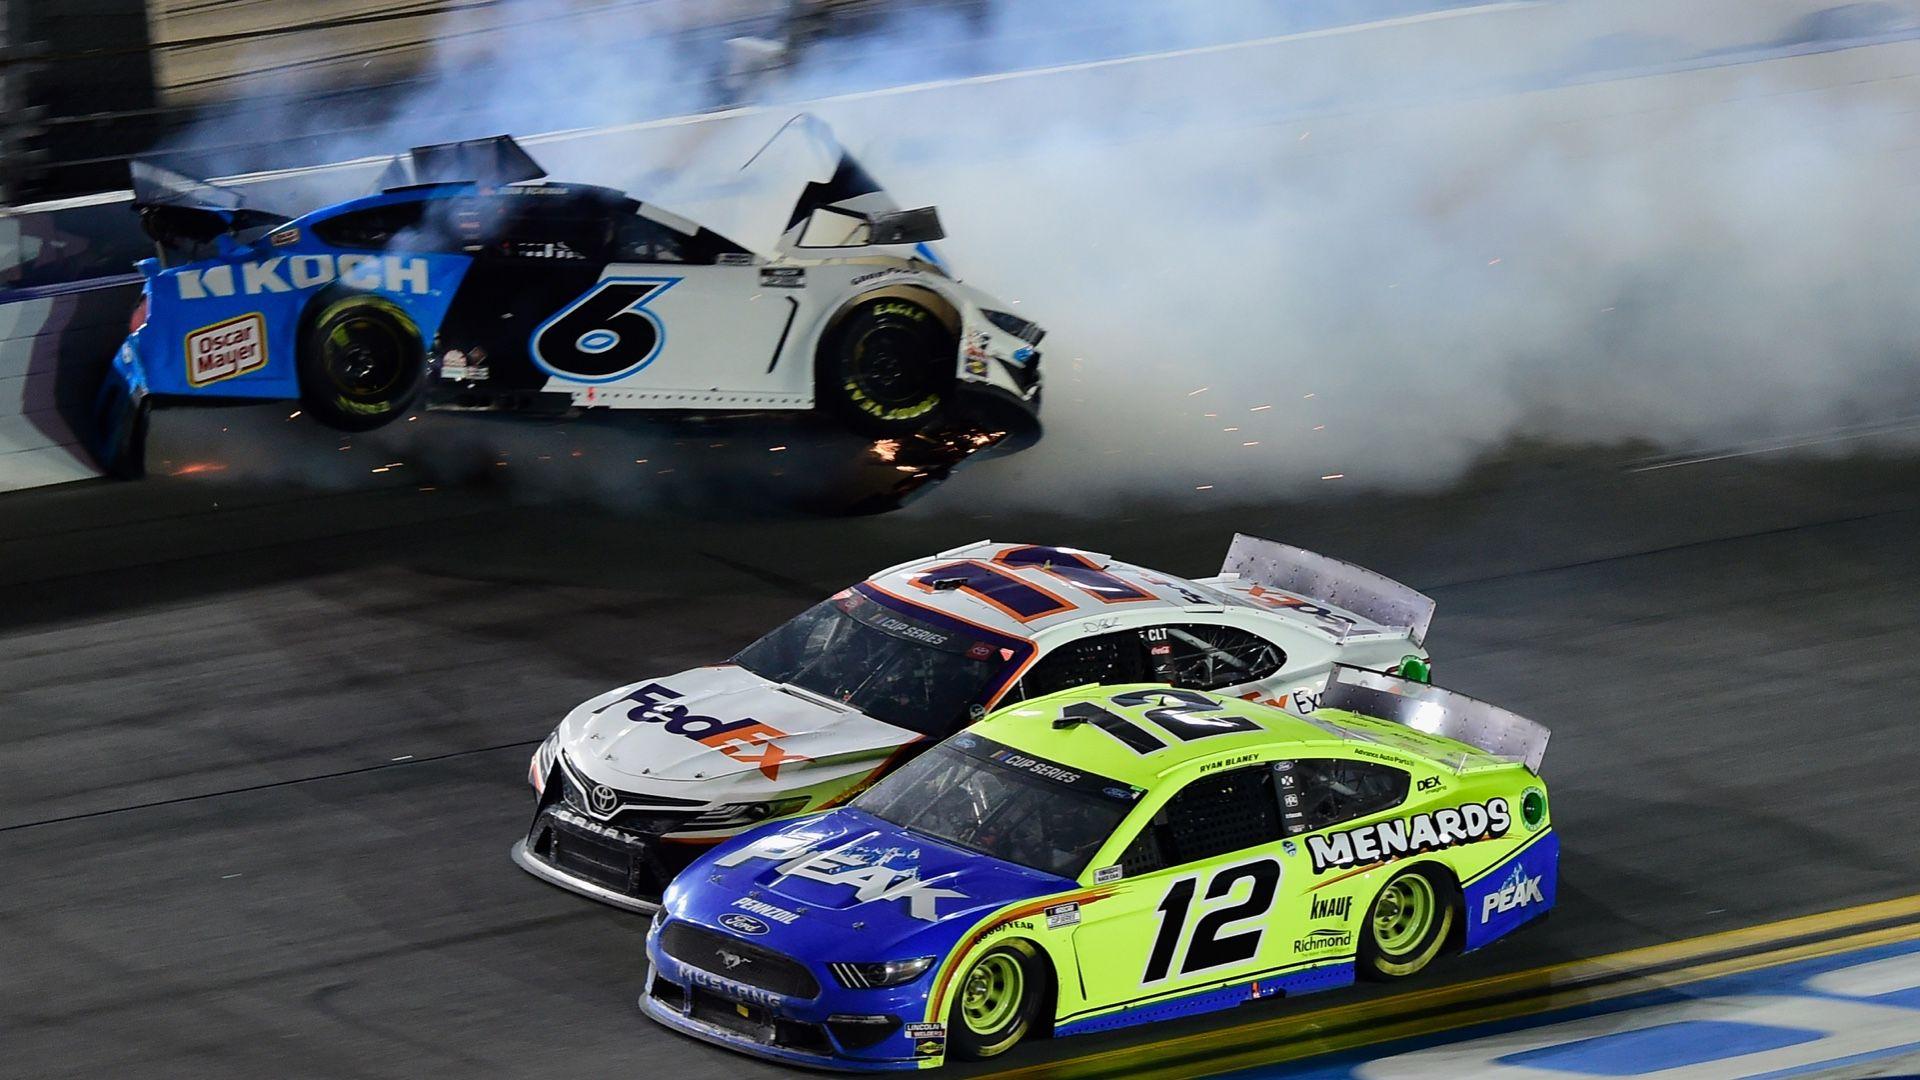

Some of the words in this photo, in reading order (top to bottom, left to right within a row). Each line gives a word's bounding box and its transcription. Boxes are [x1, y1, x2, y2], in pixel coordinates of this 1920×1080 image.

[242, 253, 429, 295] KOCH
[200, 325, 252, 354] Oscar
[531, 278, 678, 382] 6
[198, 343, 256, 374] Mayer
[907, 544, 1161, 624] 11
[883, 617, 908, 633] CUP
[905, 626, 948, 645] SERIES
[1148, 628, 1168, 641] CLT
[592, 682, 816, 782] FedEx
[1061, 688, 1265, 756] 12
[1004, 754, 1032, 772] CUP
[1029, 760, 1081, 784] SERIES
[1199, 761, 1223, 773] RYAN
[1225, 753, 1260, 766] BLANEY
[1417, 775, 1442, 791] DEX
[1306, 797, 1511, 872] MENARDS
[713, 832, 971, 923] PEAK
[731, 897, 800, 925] PENNZOIL
[1481, 875, 1544, 923] PEAK
[722, 914, 764, 933] Ford
[974, 919, 1034, 945] GOODYEAR
[1140, 857, 1282, 985] 12
[1293, 930, 1351, 954] Richmond
